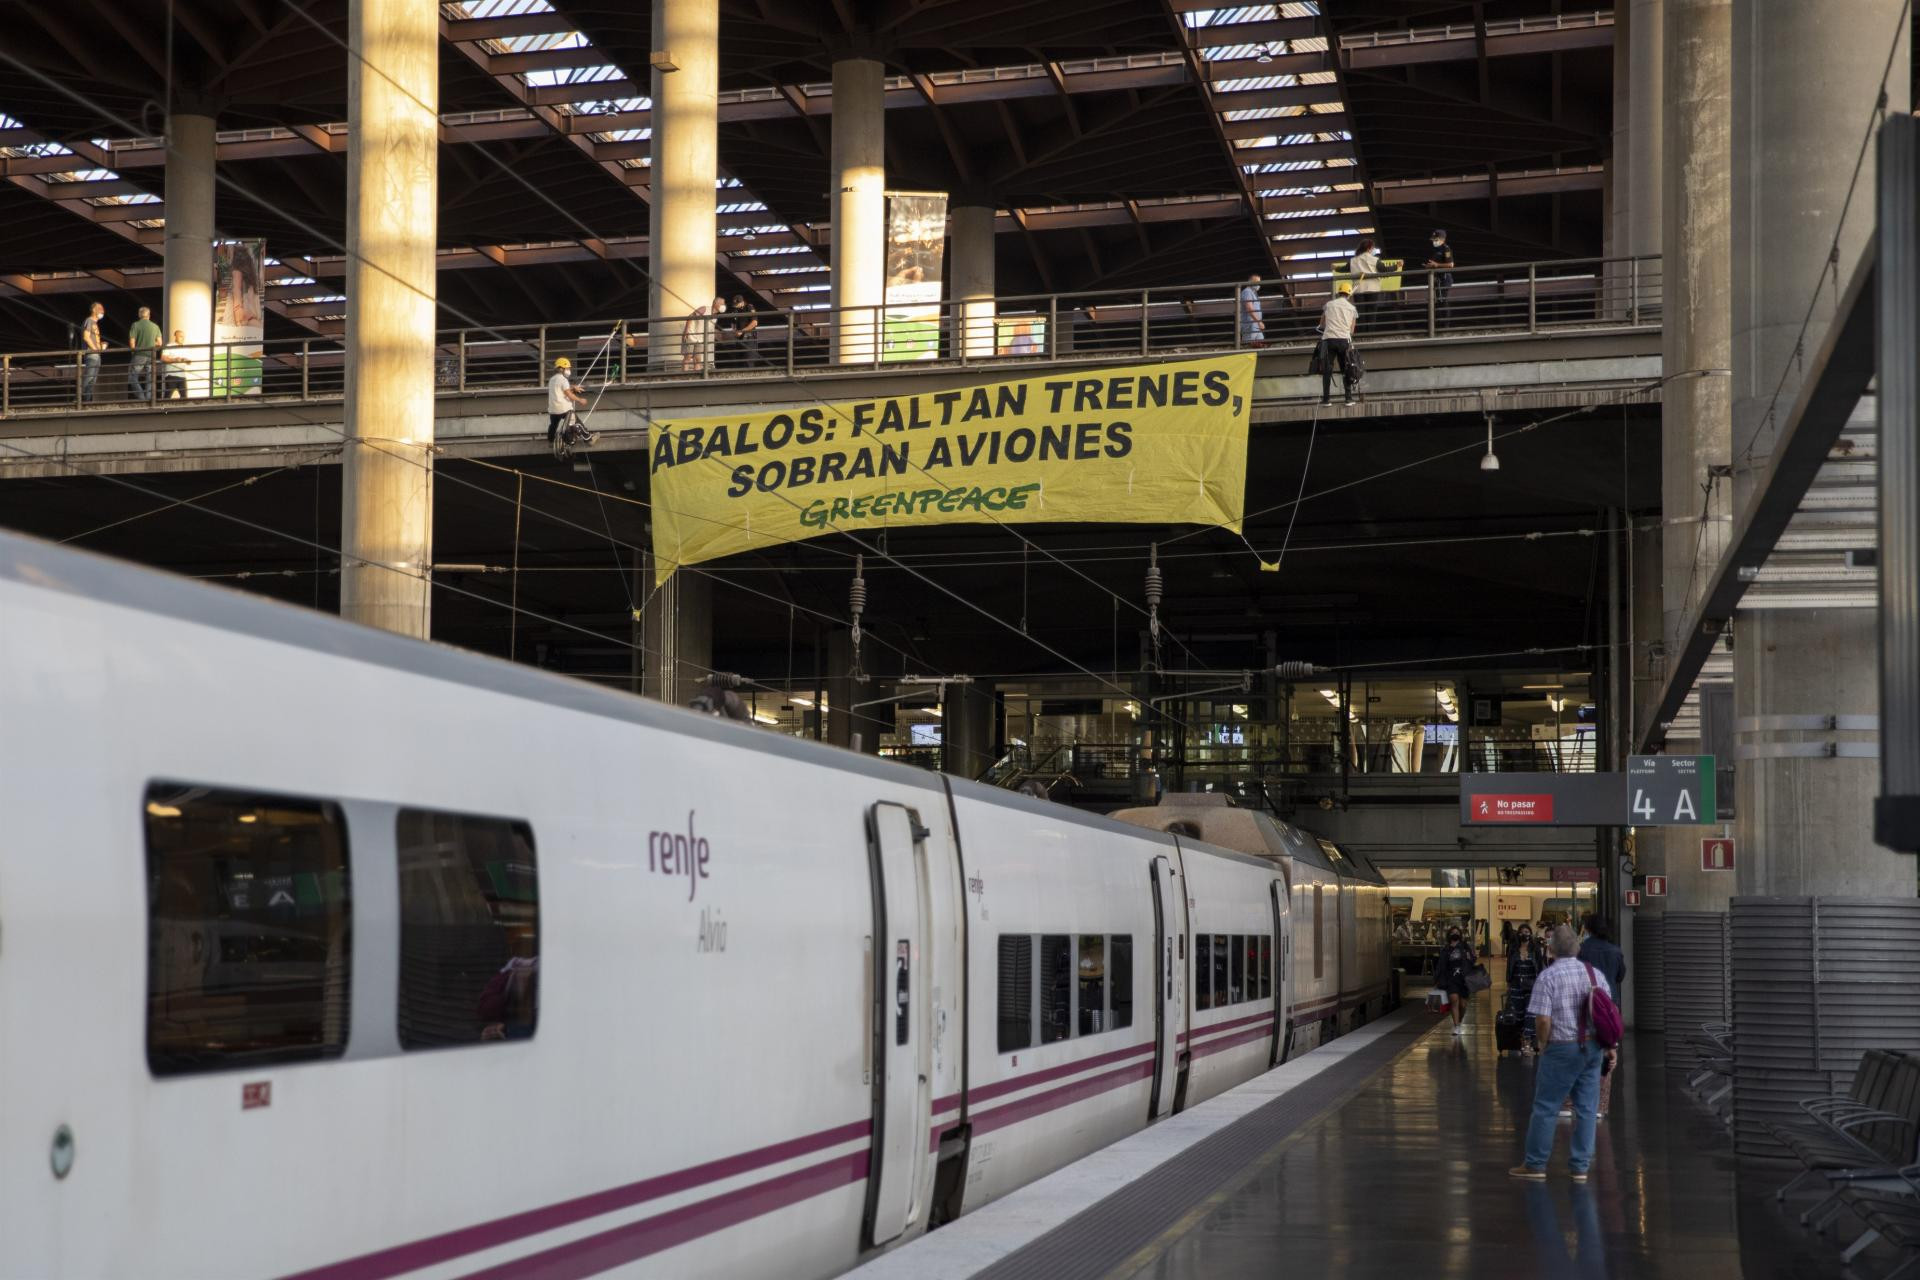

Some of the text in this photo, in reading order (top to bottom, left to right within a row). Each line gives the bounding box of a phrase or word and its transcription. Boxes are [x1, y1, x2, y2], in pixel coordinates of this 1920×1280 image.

[651, 370, 1243, 475] ÁBALOS: FALTAN TRENES,
[727, 421, 1133, 498] SOBRAN AVIONES
[800, 483, 1041, 530] GREENPEACE
[1671, 759, 1696, 767] Sector
[1497, 800, 1536, 810] No pasar
[1632, 788, 1656, 820] 4
[1673, 788, 1697, 820] A
[648, 809, 710, 902] renfe
